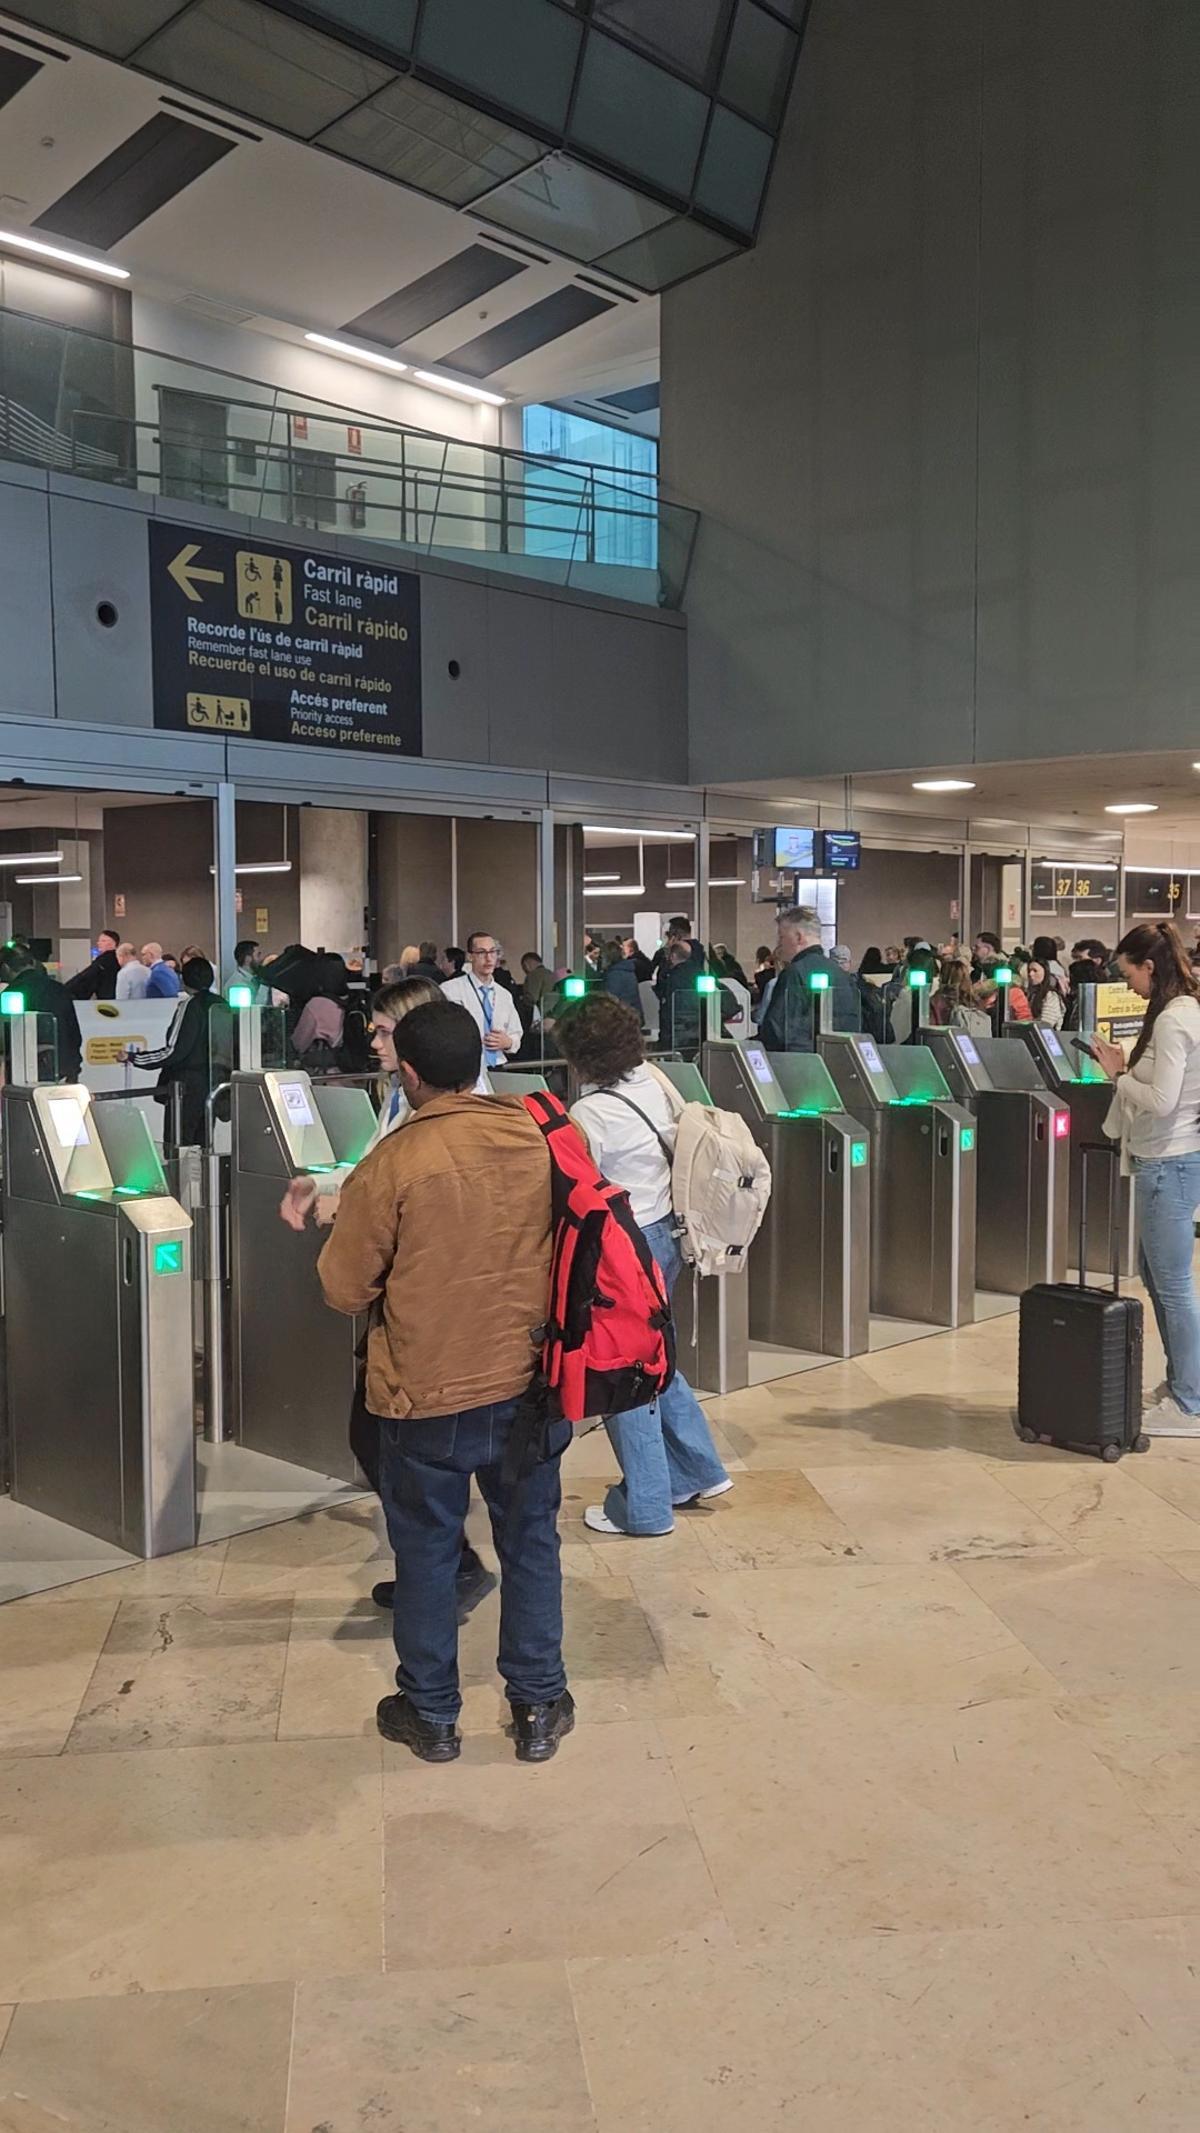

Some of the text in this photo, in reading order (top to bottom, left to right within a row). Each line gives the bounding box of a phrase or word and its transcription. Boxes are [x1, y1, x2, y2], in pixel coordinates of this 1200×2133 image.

[303, 558, 398, 595] Carril ràpid
[303, 583, 362, 609] Fast lane
[305, 606, 352, 632] Carril
[187, 616, 363, 659] Recorde l'ús de carril ràpid
[188, 636, 312, 666] Remember fast lane use
[188, 650, 392, 693] Recuerde el uso de carril rápido
[290, 689, 388, 715] Accés preferent
[290, 707, 354, 726] Priority access
[291, 721, 402, 746] Acceso preferente
[1056, 879, 1072, 896] 37
[1075, 880, 1091, 897] 36
[1167, 883, 1180, 900] 35
